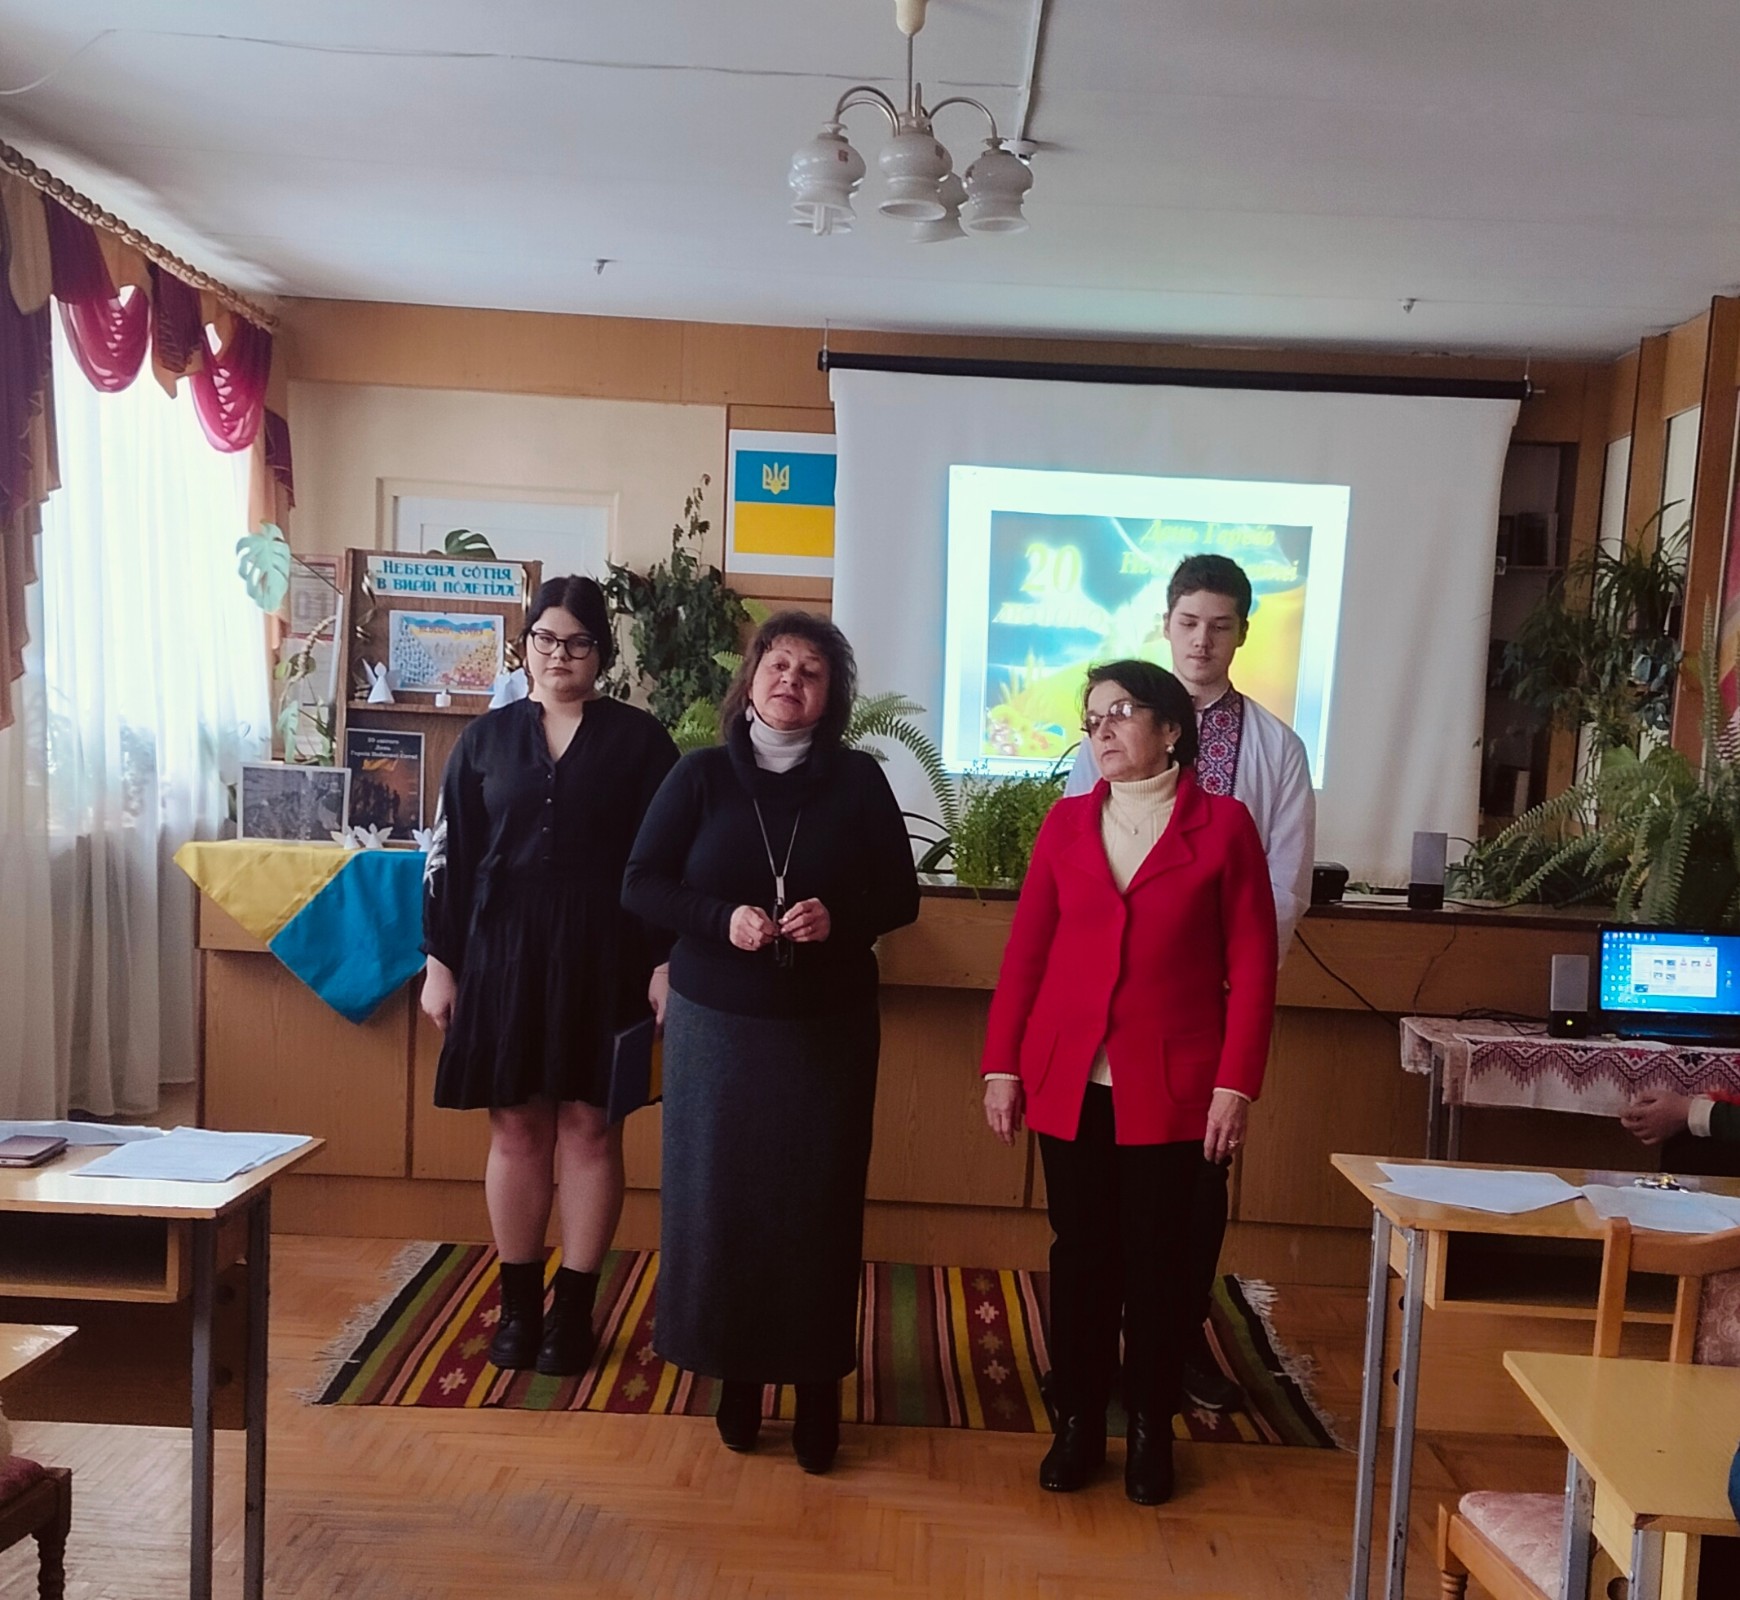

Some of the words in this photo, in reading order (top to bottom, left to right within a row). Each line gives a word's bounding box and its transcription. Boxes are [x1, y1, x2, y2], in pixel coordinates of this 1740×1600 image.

[461, 565, 512, 580] СОТНЯ
[1020, 543, 1081, 594] 20
[376, 577, 387, 589] В
